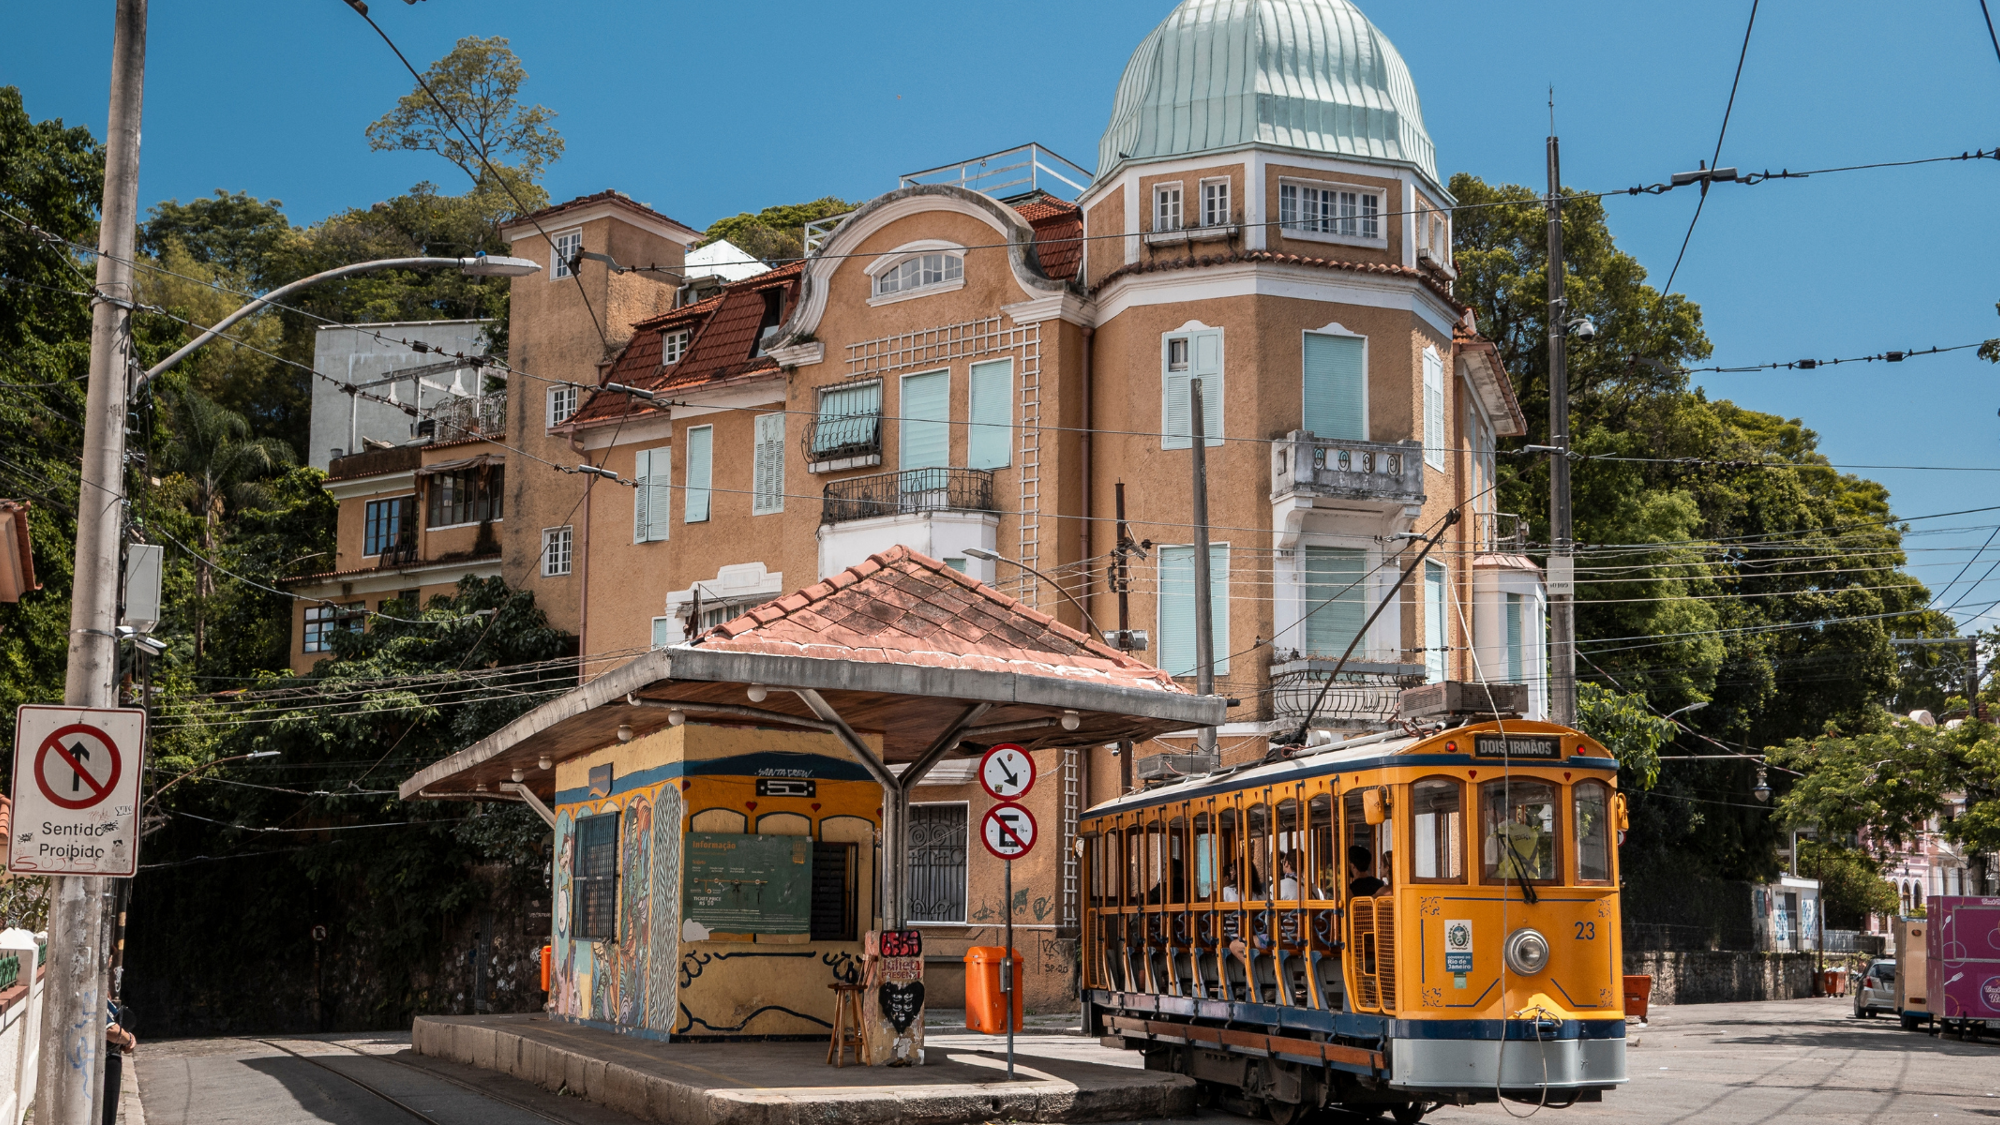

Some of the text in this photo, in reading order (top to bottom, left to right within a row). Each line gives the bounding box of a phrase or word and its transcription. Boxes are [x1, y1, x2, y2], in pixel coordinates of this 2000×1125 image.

[1480, 738, 1552, 755] DOIS IRMÃOS
[42, 821, 105, 837] Sentido
[999, 815, 1019, 847] E
[39, 843, 105, 859] Proibido
[692, 841, 736, 851] Informação
[1574, 921, 1595, 940] 23
[881, 971, 920, 979] PRESEN
